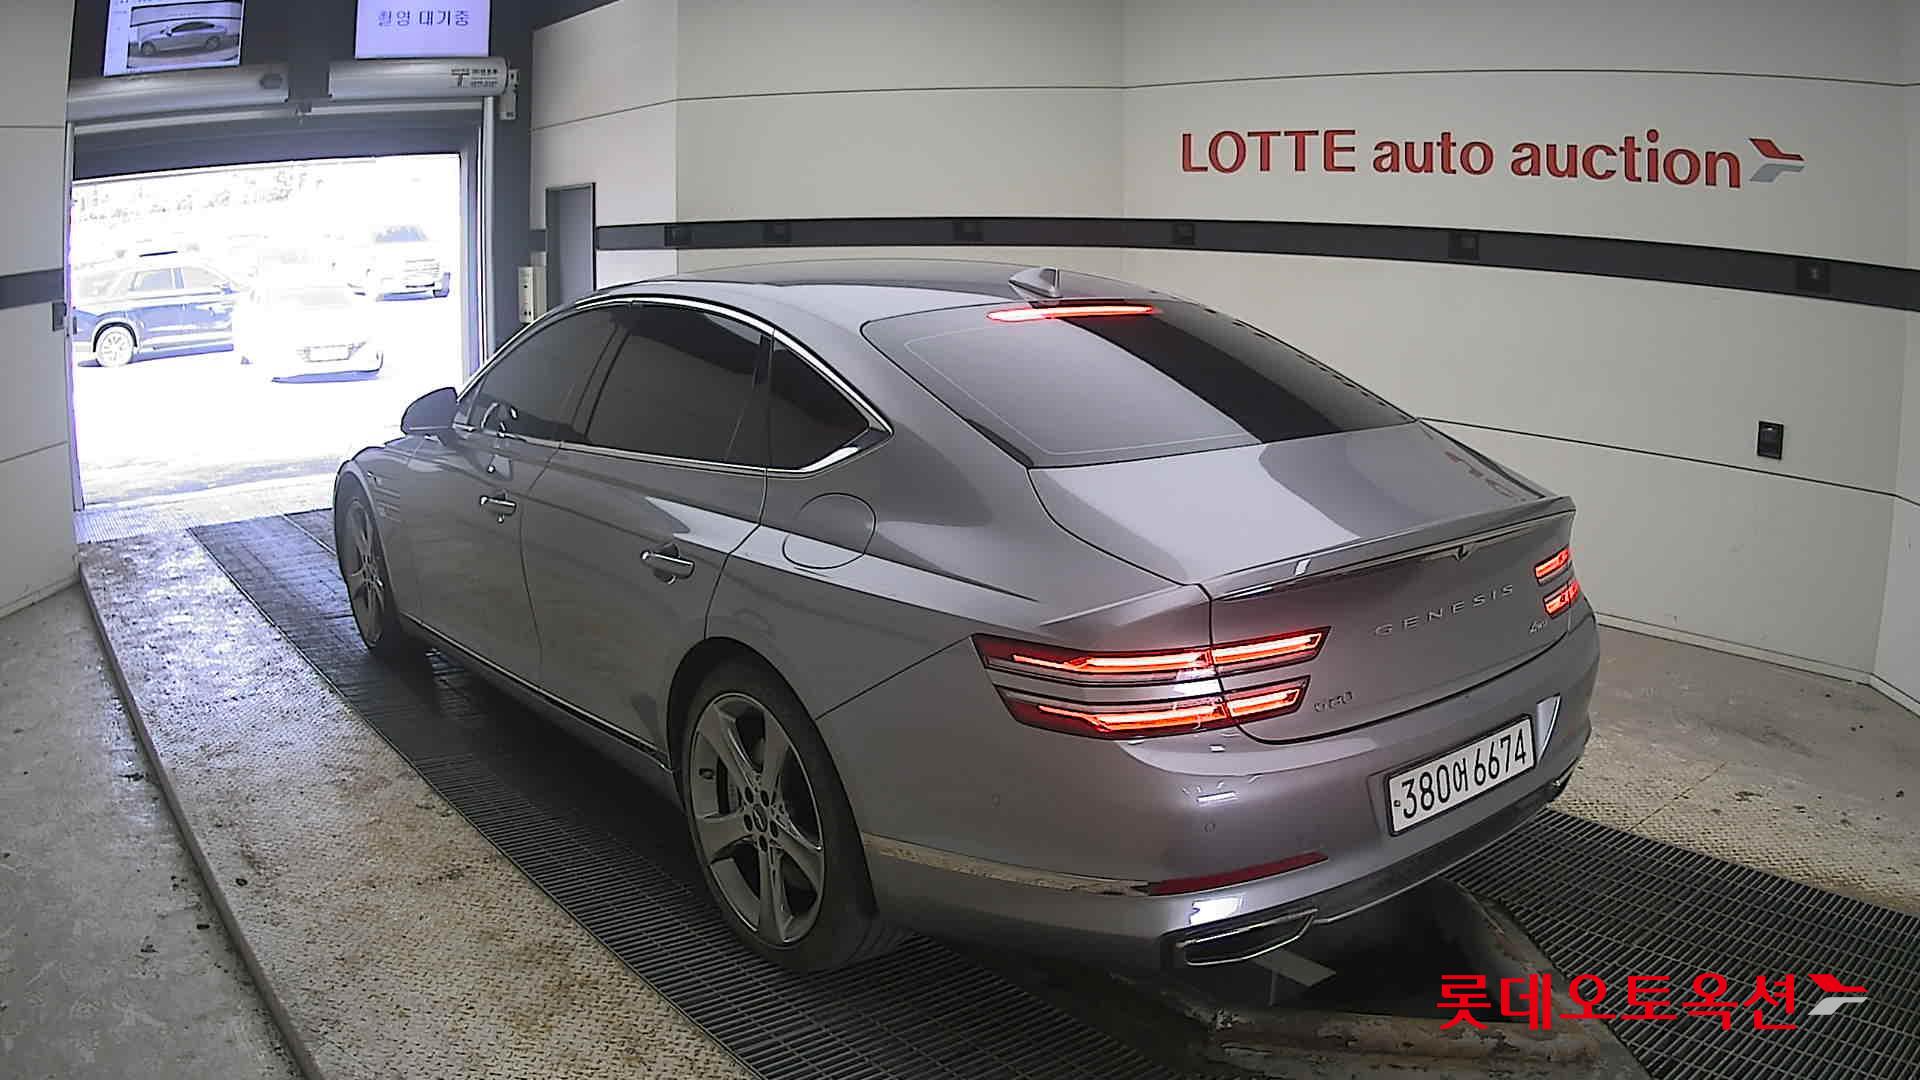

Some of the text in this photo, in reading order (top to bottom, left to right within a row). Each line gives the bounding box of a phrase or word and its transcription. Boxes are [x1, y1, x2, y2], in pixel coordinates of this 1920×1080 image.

[419, 10, 469, 27] 대기중
[1182, 130, 1742, 188] LOTTE auto auction
[1375, 584, 1514, 637] GENESIS
